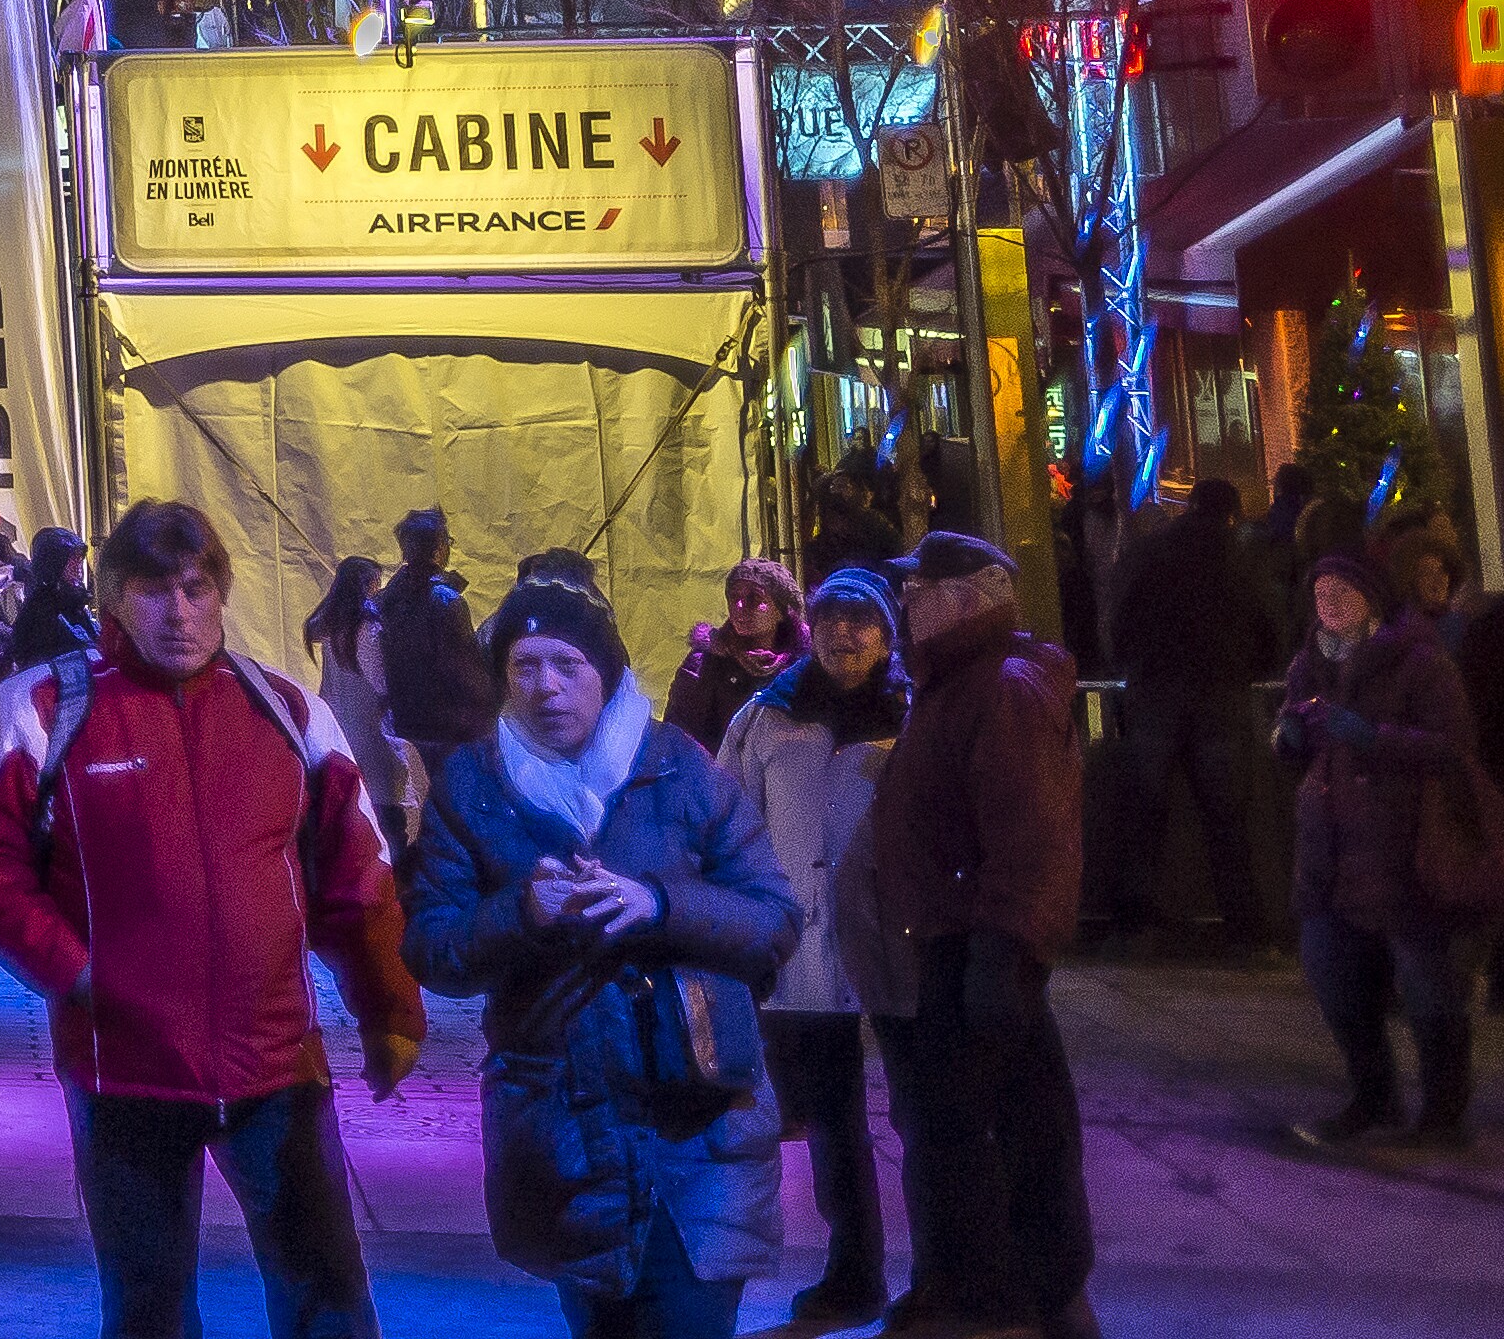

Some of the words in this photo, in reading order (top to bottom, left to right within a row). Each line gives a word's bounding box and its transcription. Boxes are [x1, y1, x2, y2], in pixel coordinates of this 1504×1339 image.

[364, 111, 616, 174] CABINE
[149, 155, 248, 179] MONTRÉAL
[146, 181, 168, 200] EN
[174, 179, 254, 200] LUMIÈRE
[188, 212, 215, 227] Bell
[368, 210, 586, 234] AIRFRANCE
